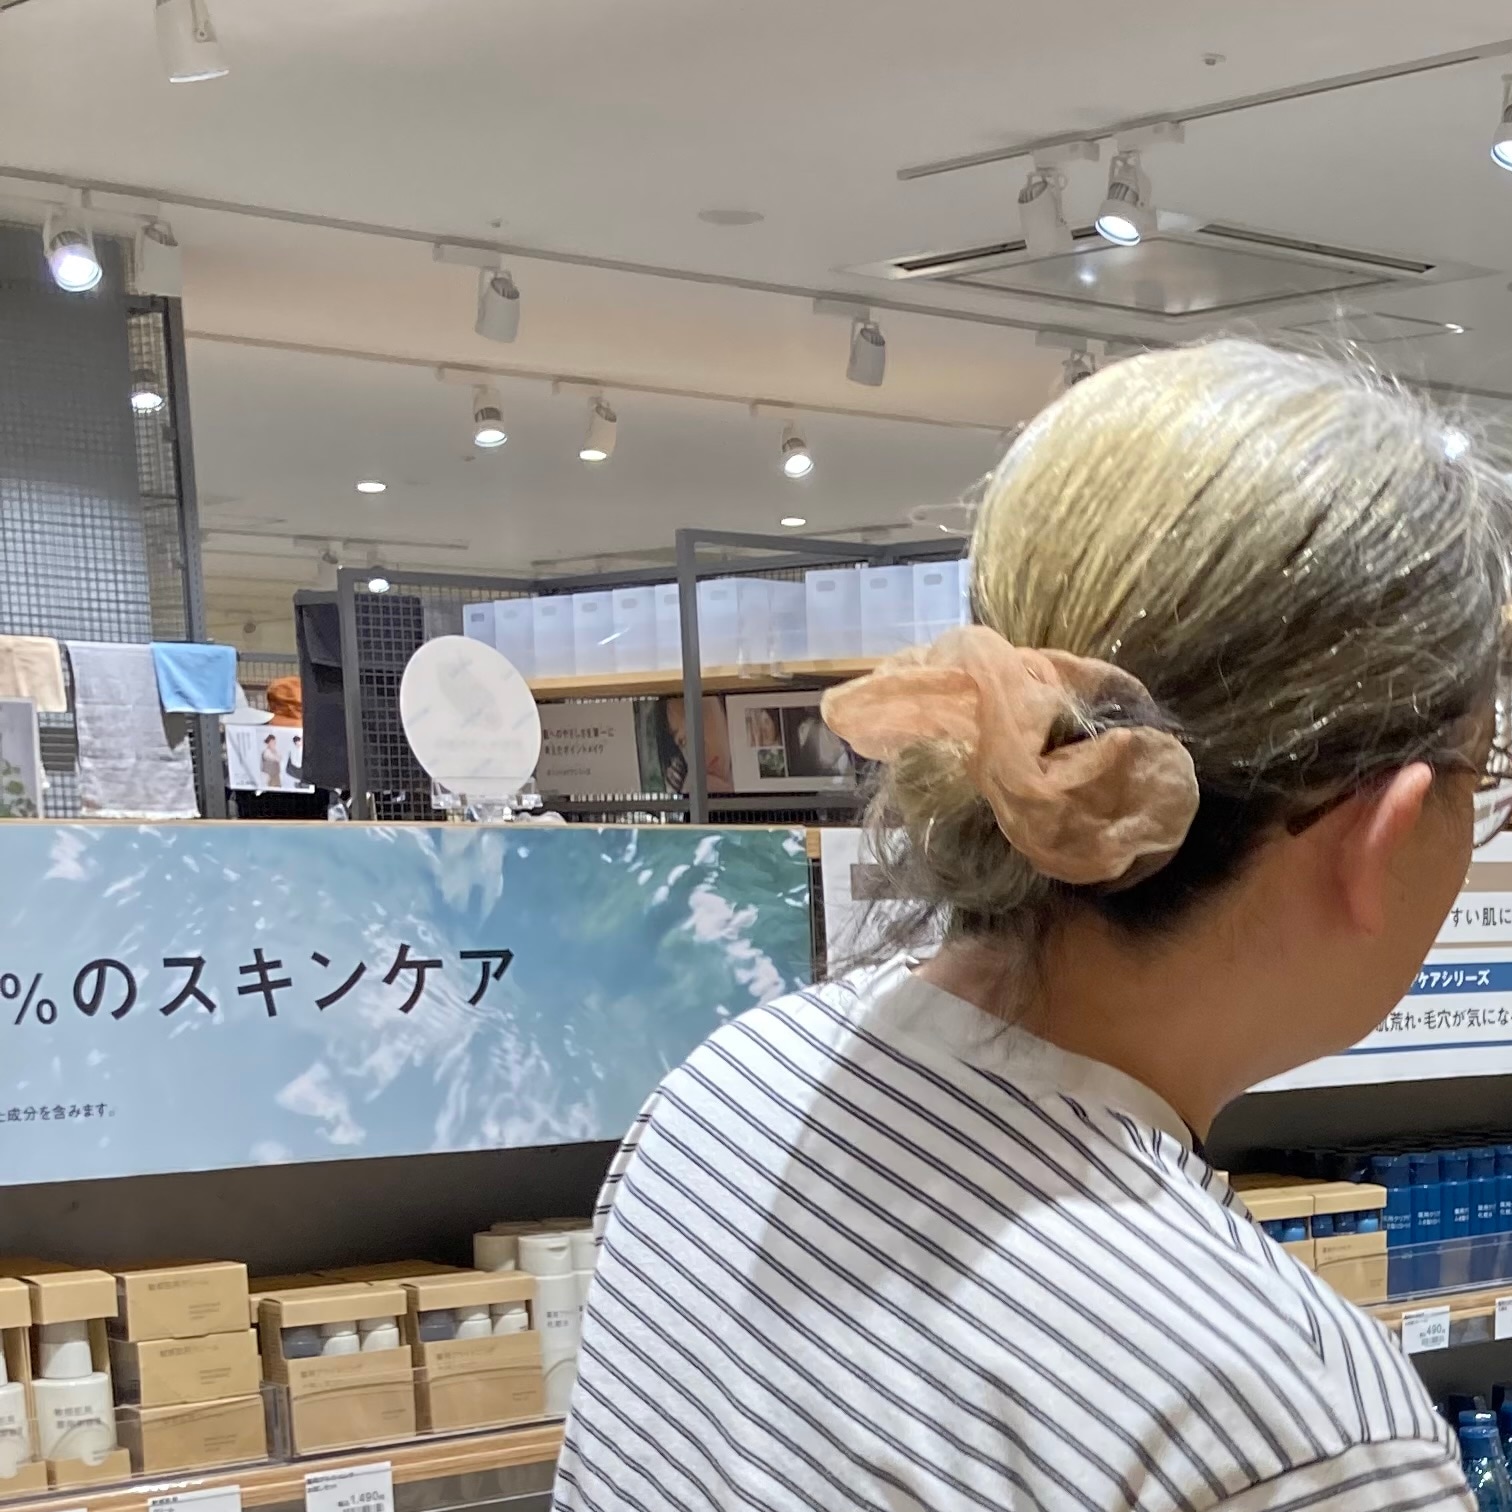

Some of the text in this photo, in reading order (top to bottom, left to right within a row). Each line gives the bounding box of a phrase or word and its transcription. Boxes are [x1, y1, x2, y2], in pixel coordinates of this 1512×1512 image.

[1410, 969, 1491, 989] ケアシリーズ
